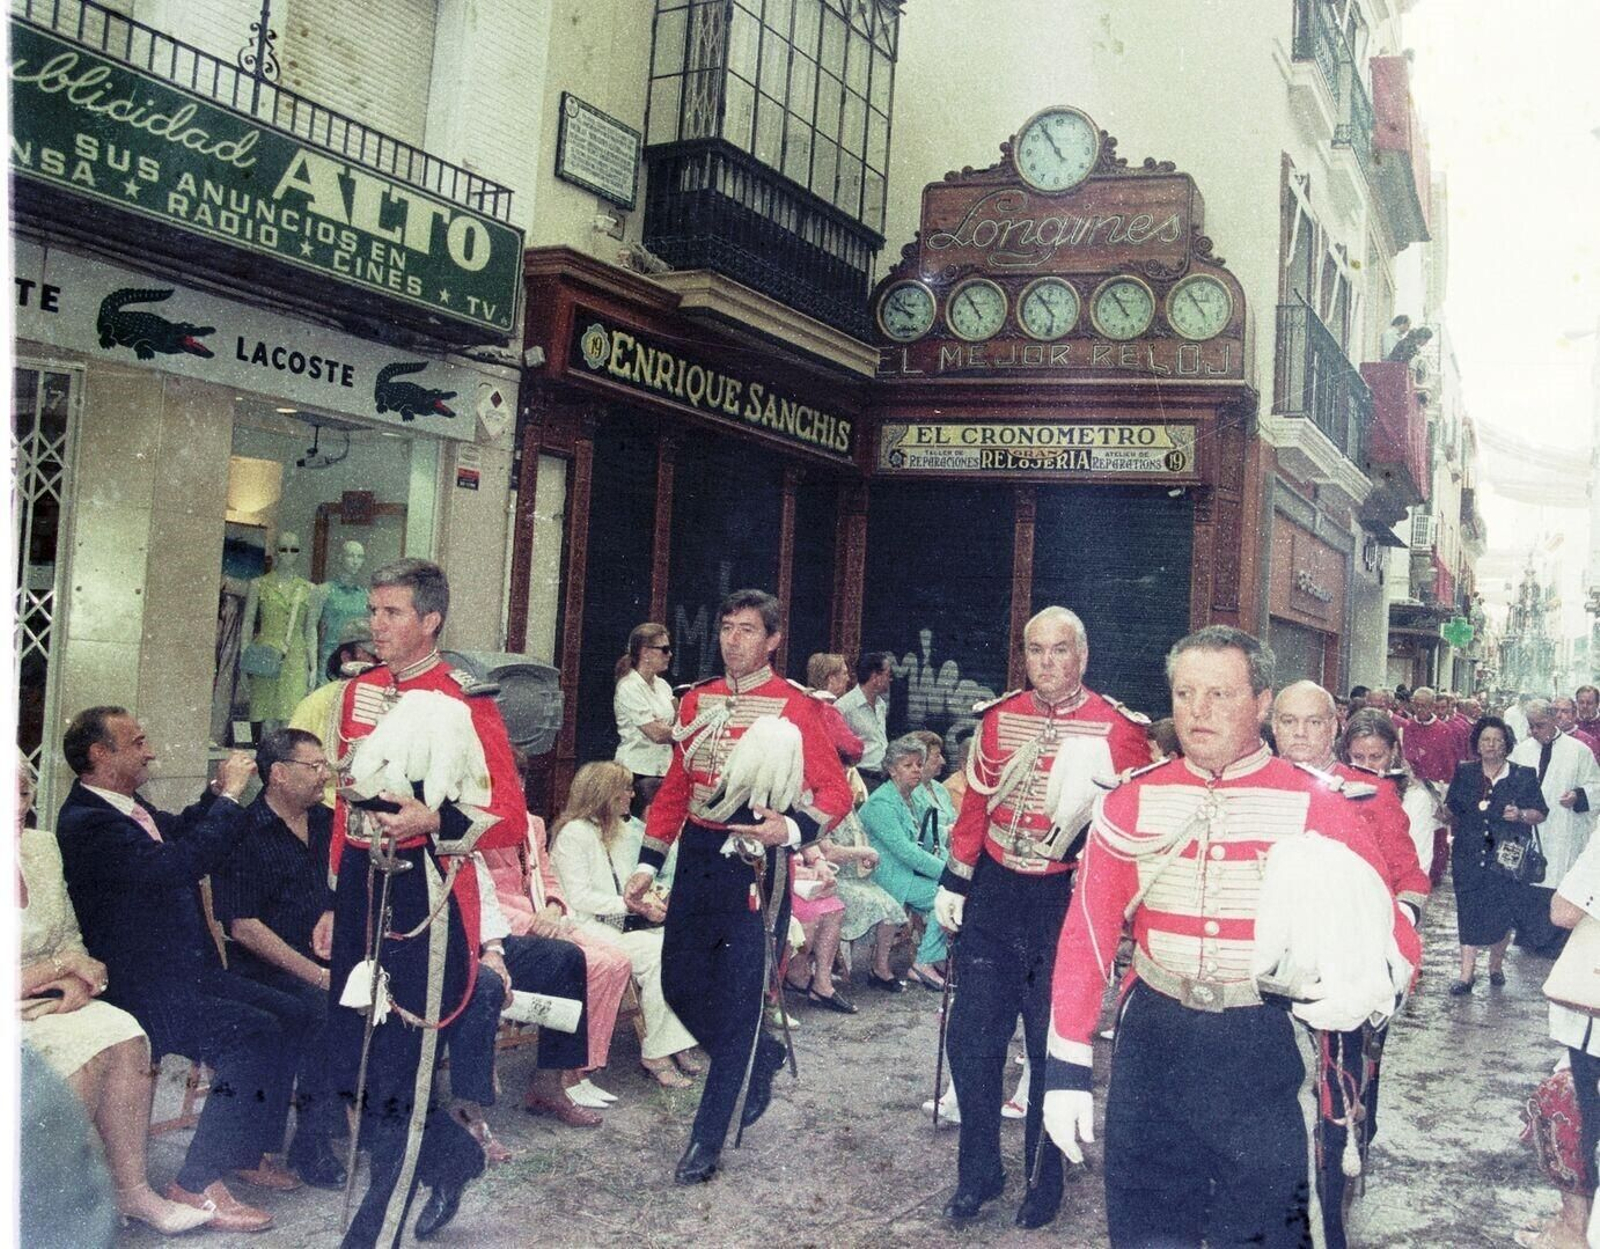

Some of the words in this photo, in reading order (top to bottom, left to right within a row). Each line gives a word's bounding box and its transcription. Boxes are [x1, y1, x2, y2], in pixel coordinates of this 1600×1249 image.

[74, 132, 161, 183] SUS
[176, 171, 359, 255] ANUNCIOS
[371, 240, 406, 271] EN
[272, 148, 491, 272] ALTO
[926, 187, 1183, 267] Longines
[167, 191, 279, 249] RADIO
[333, 249, 423, 297] CINES
[466, 295, 496, 321] TV
[235, 336, 355, 388] LACOSTE
[876, 345, 924, 375] EL
[939, 344, 1071, 371] MEJOR
[1091, 343, 1230, 375] RELOJ
[607, 330, 742, 415] ENRIQUE
[745, 382, 851, 452] SANCHIS
[909, 455, 980, 469] REPARACIONES
[916, 426, 951, 445] EL
[960, 426, 1156, 446] CRONOMETRO
[981, 450, 1090, 470] RELOJERIA
[1168, 451, 1183, 470] 19
